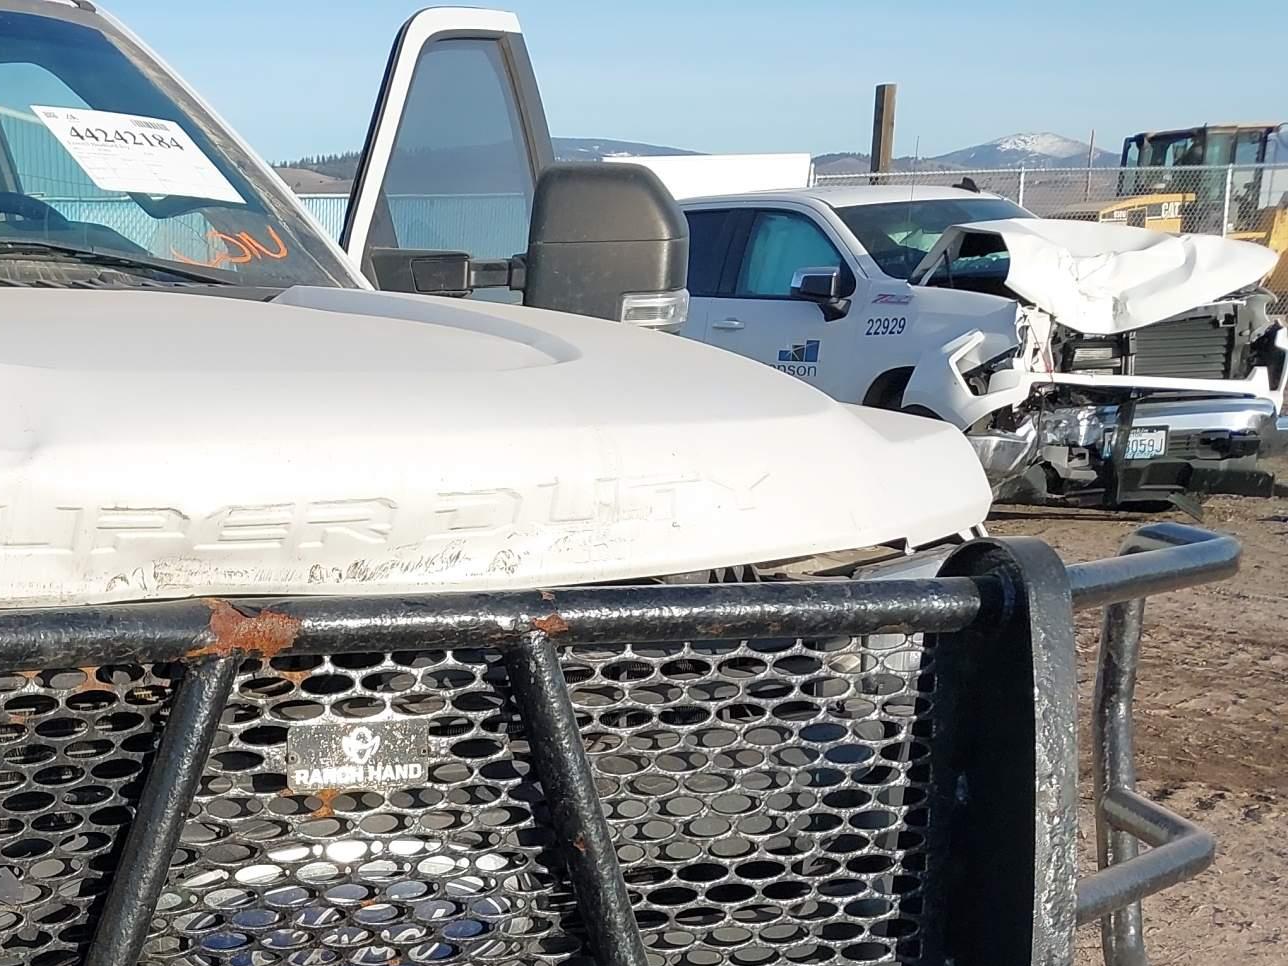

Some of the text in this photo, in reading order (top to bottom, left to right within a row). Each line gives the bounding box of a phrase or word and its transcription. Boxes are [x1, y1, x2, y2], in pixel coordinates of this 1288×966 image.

[70, 126, 184, 151] 44242184
[1161, 202, 1182, 218] CAT
[865, 317, 906, 336] 22929
[769, 364, 817, 377] nson
[424, 474, 772, 537] DUTY
[370, 763, 422, 782] HAND
